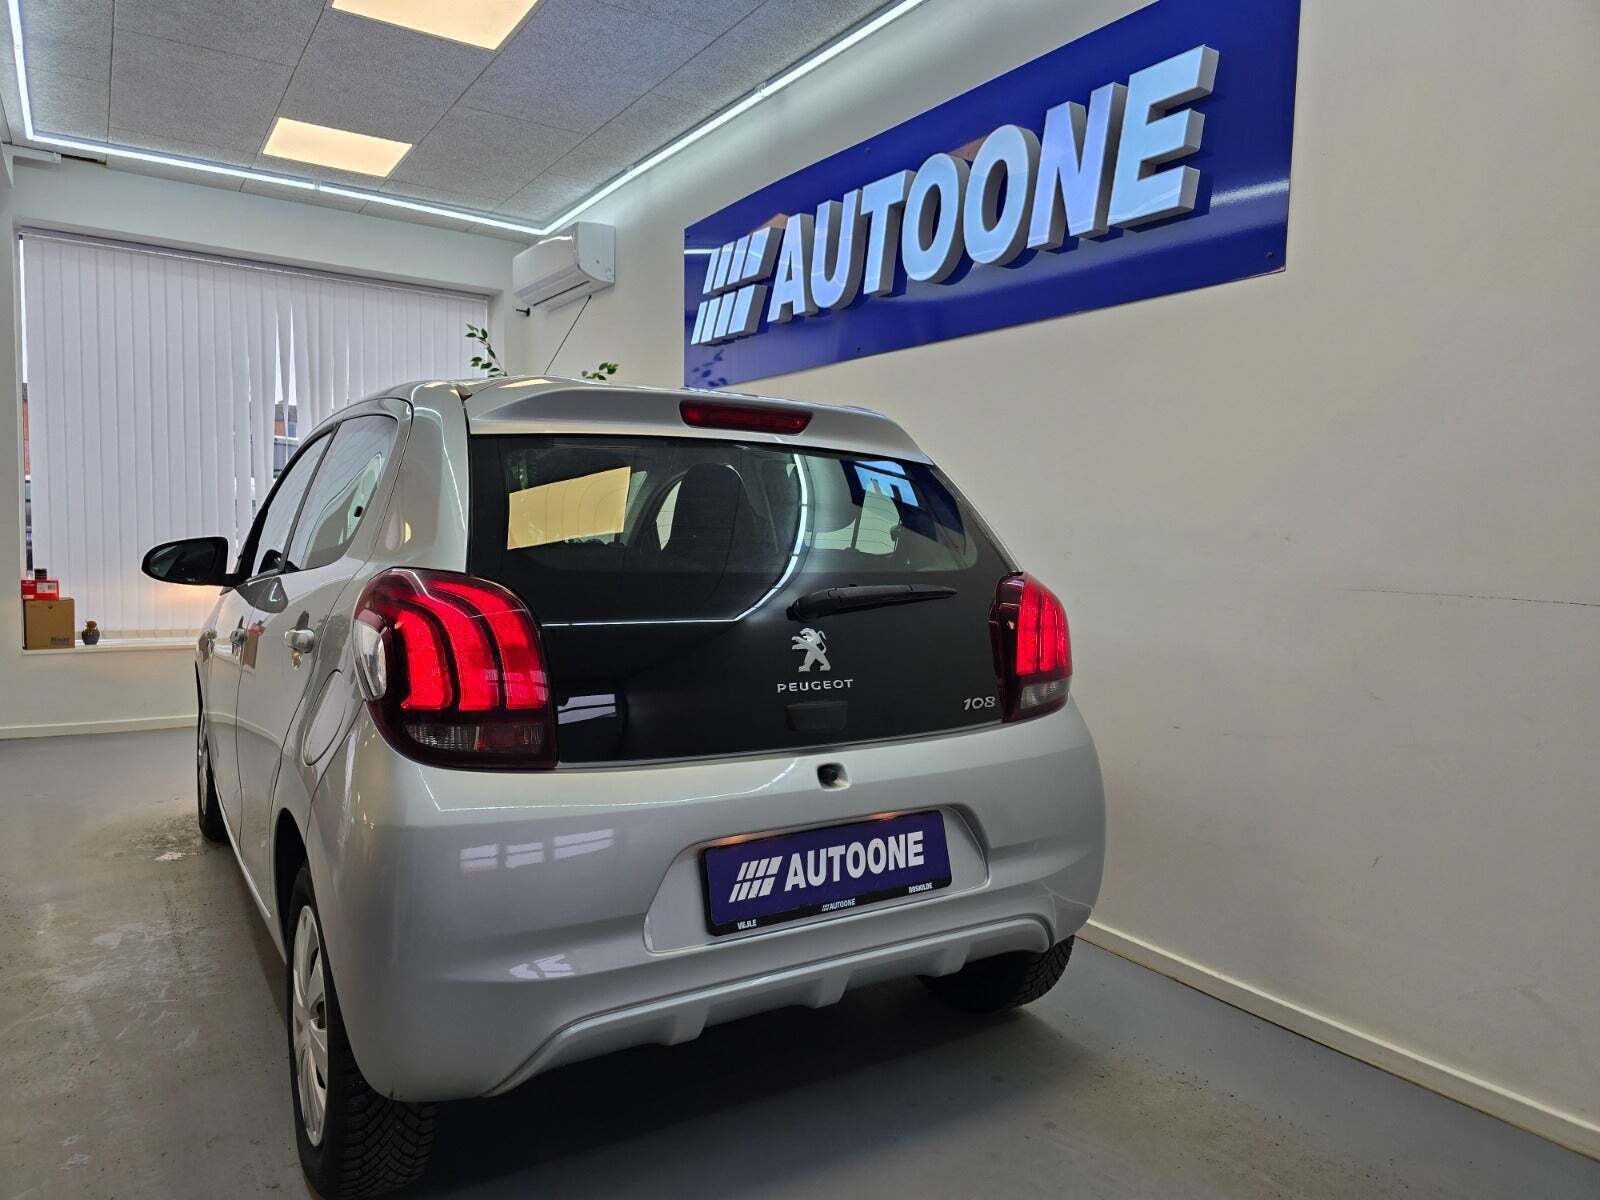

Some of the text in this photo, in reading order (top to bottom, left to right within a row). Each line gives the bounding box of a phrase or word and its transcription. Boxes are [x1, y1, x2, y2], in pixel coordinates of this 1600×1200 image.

[767, 45, 1219, 324] AUTOONE
[777, 679, 854, 693] PEUGEOT
[963, 696, 996, 711] 108
[784, 831, 925, 892] AUTOONE
[829, 898, 856, 911] AUTOONE
[737, 918, 757, 930] VEJLE
